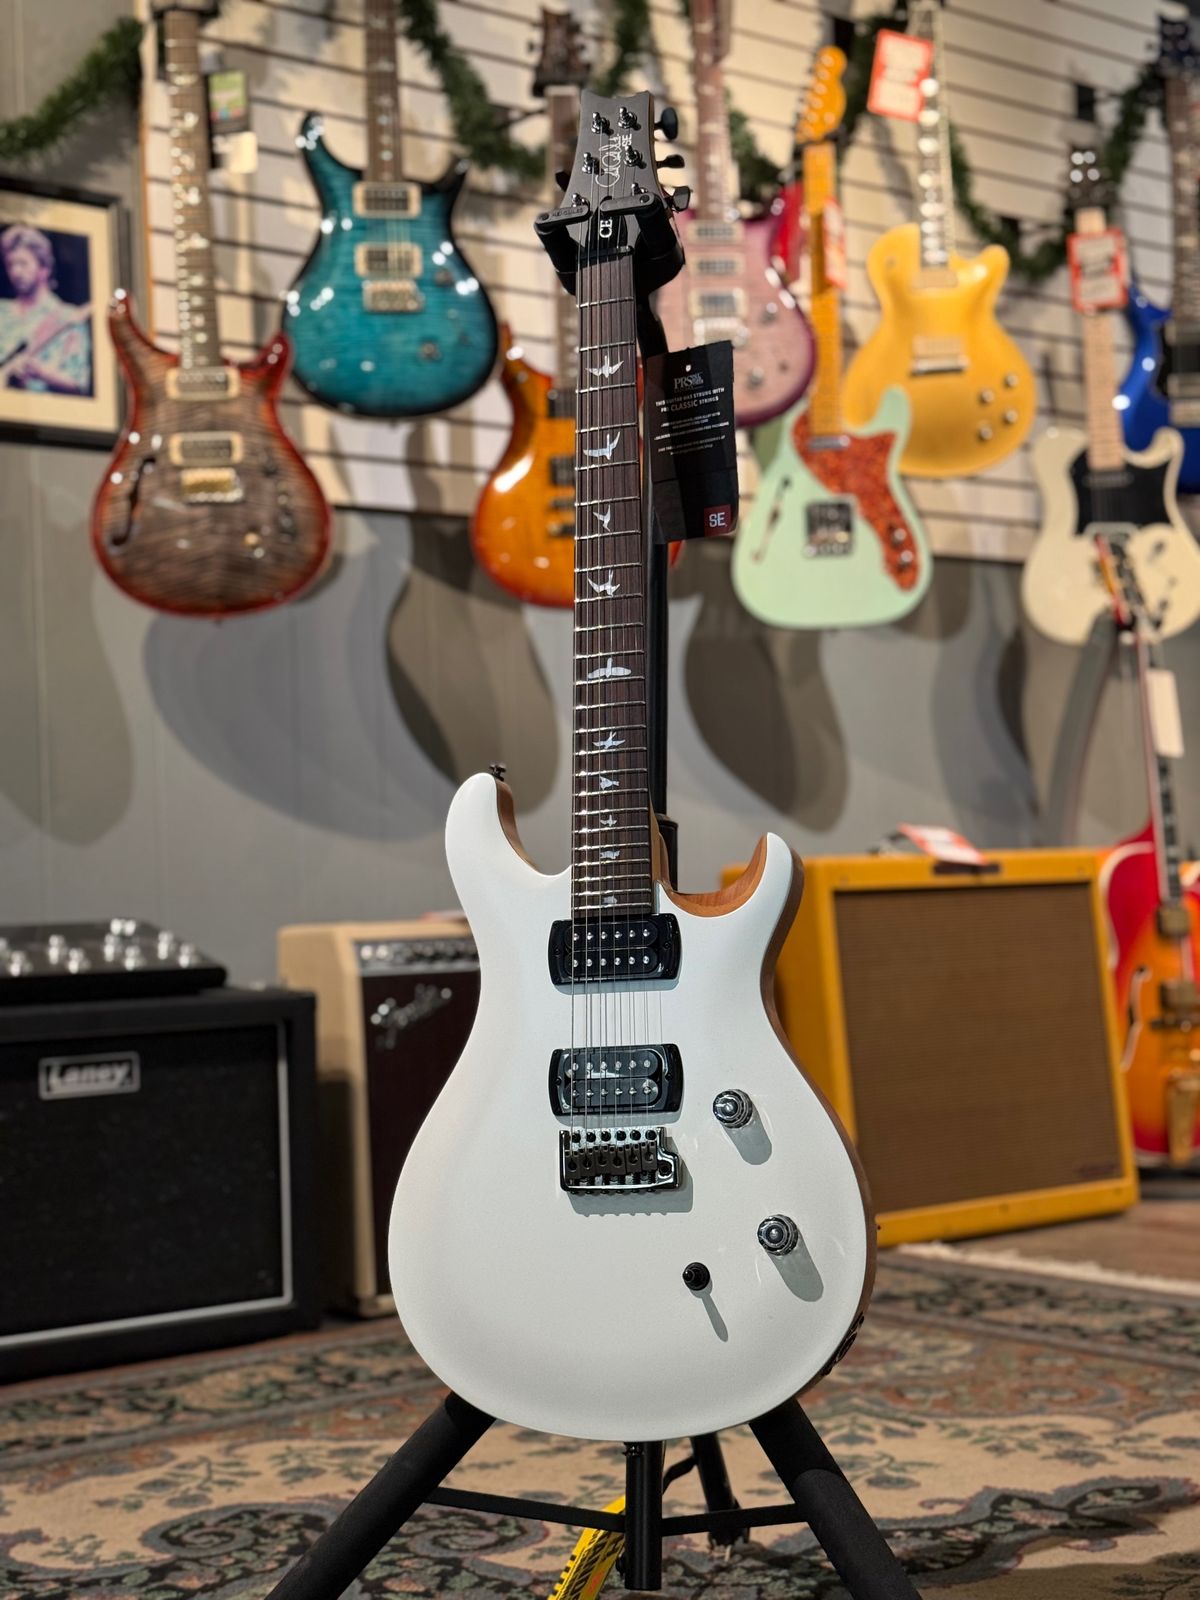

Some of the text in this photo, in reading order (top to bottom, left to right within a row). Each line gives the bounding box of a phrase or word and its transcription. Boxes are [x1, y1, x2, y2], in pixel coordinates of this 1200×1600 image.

[622, 133, 633, 147] SE
[599, 218, 613, 238] CE
[674, 375, 693, 389] PRS
[693, 390, 712, 398] STRUNG
[670, 400, 698, 412] CLASSIC
[698, 395, 719, 405] STRINGS
[708, 511, 726, 527] SE
[50, 1061, 131, 1096] Laney
